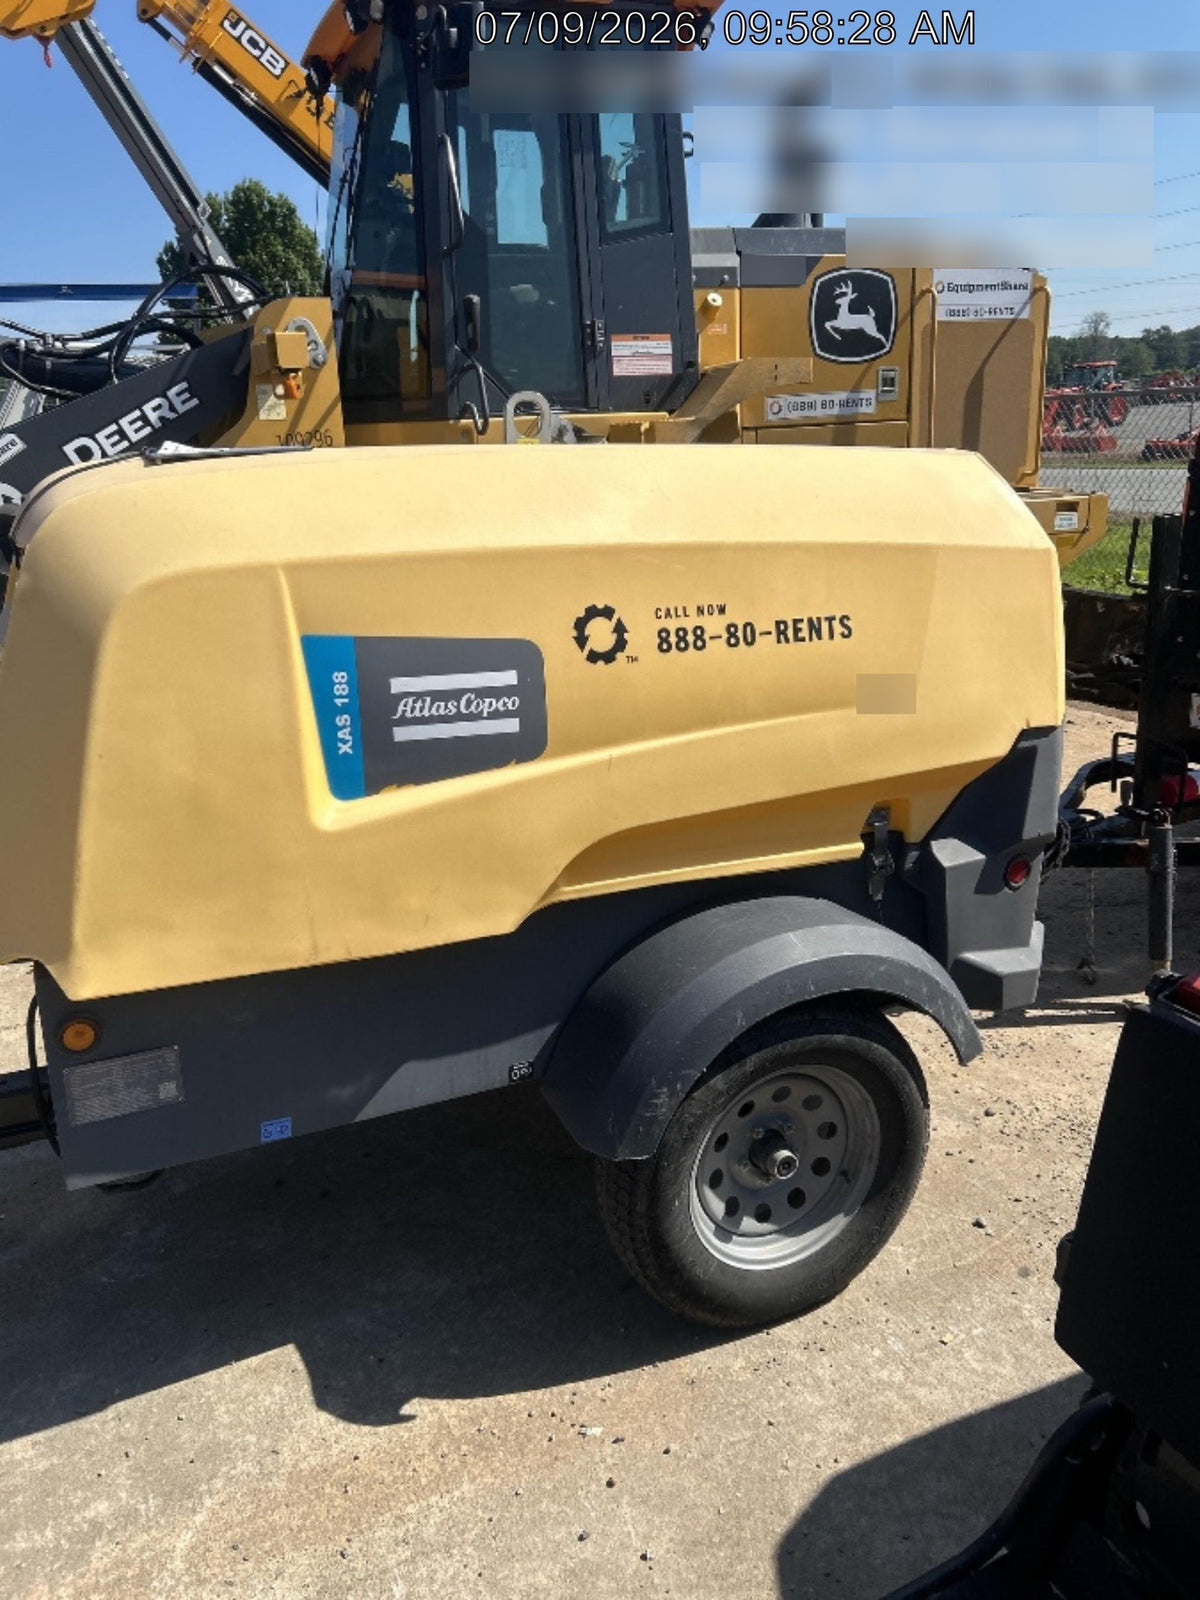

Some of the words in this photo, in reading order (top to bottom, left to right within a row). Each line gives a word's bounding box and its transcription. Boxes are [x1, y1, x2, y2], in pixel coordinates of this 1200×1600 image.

[222, 18, 286, 77] JCB
[62, 381, 200, 466] DEERE
[655, 606, 690, 619] CALL
[696, 603, 727, 616] NOW
[656, 614, 853, 653] 888-80-RENTS
[332, 671, 350, 707] 188
[390, 696, 458, 719] Atlas
[459, 692, 520, 717] Copco
[336, 714, 353, 755] XAS
